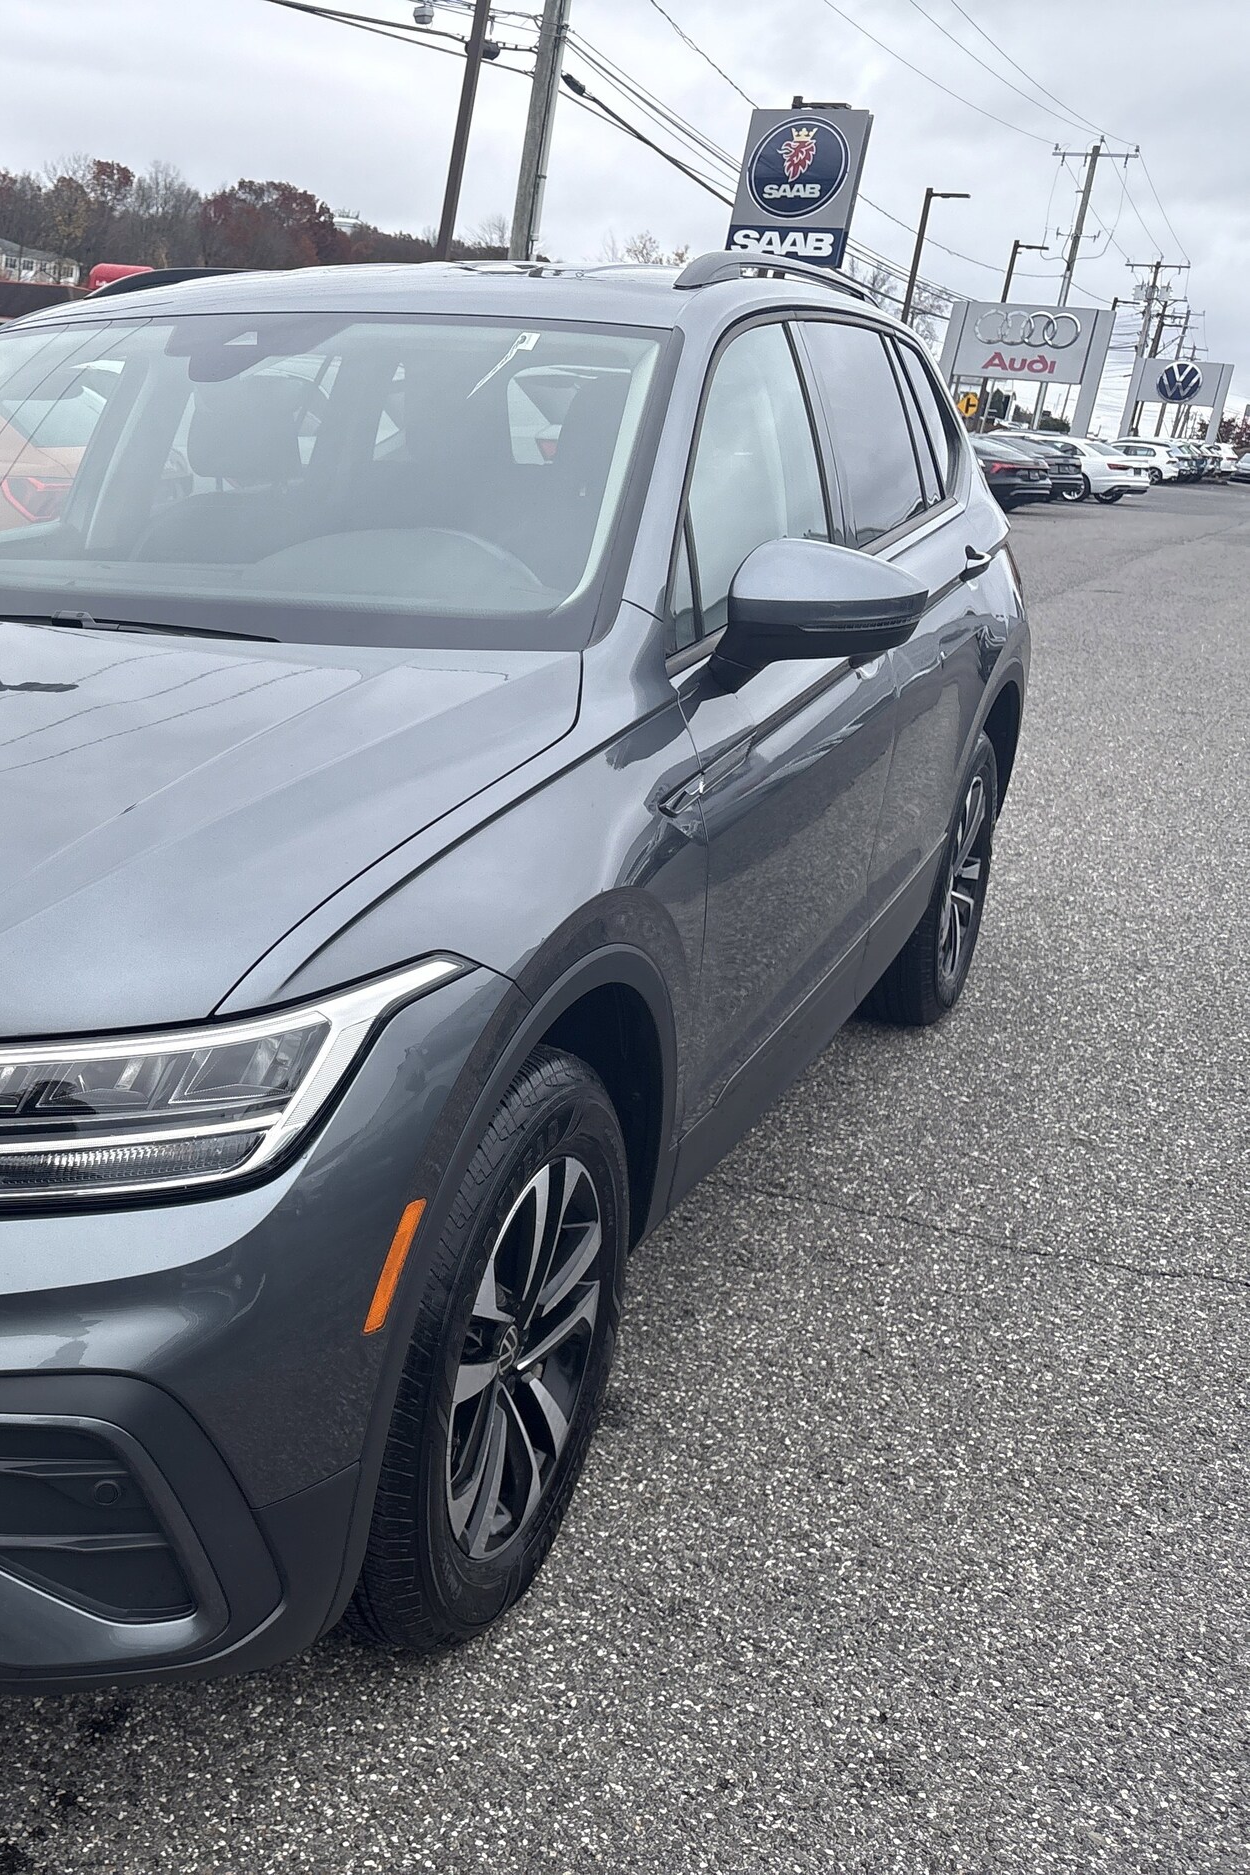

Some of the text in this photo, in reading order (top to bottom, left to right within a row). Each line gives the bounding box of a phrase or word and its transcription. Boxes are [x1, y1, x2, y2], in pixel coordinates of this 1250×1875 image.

[763, 183, 821, 199] SAAB
[730, 229, 834, 257] SAAB
[981, 351, 1057, 374] Audi
